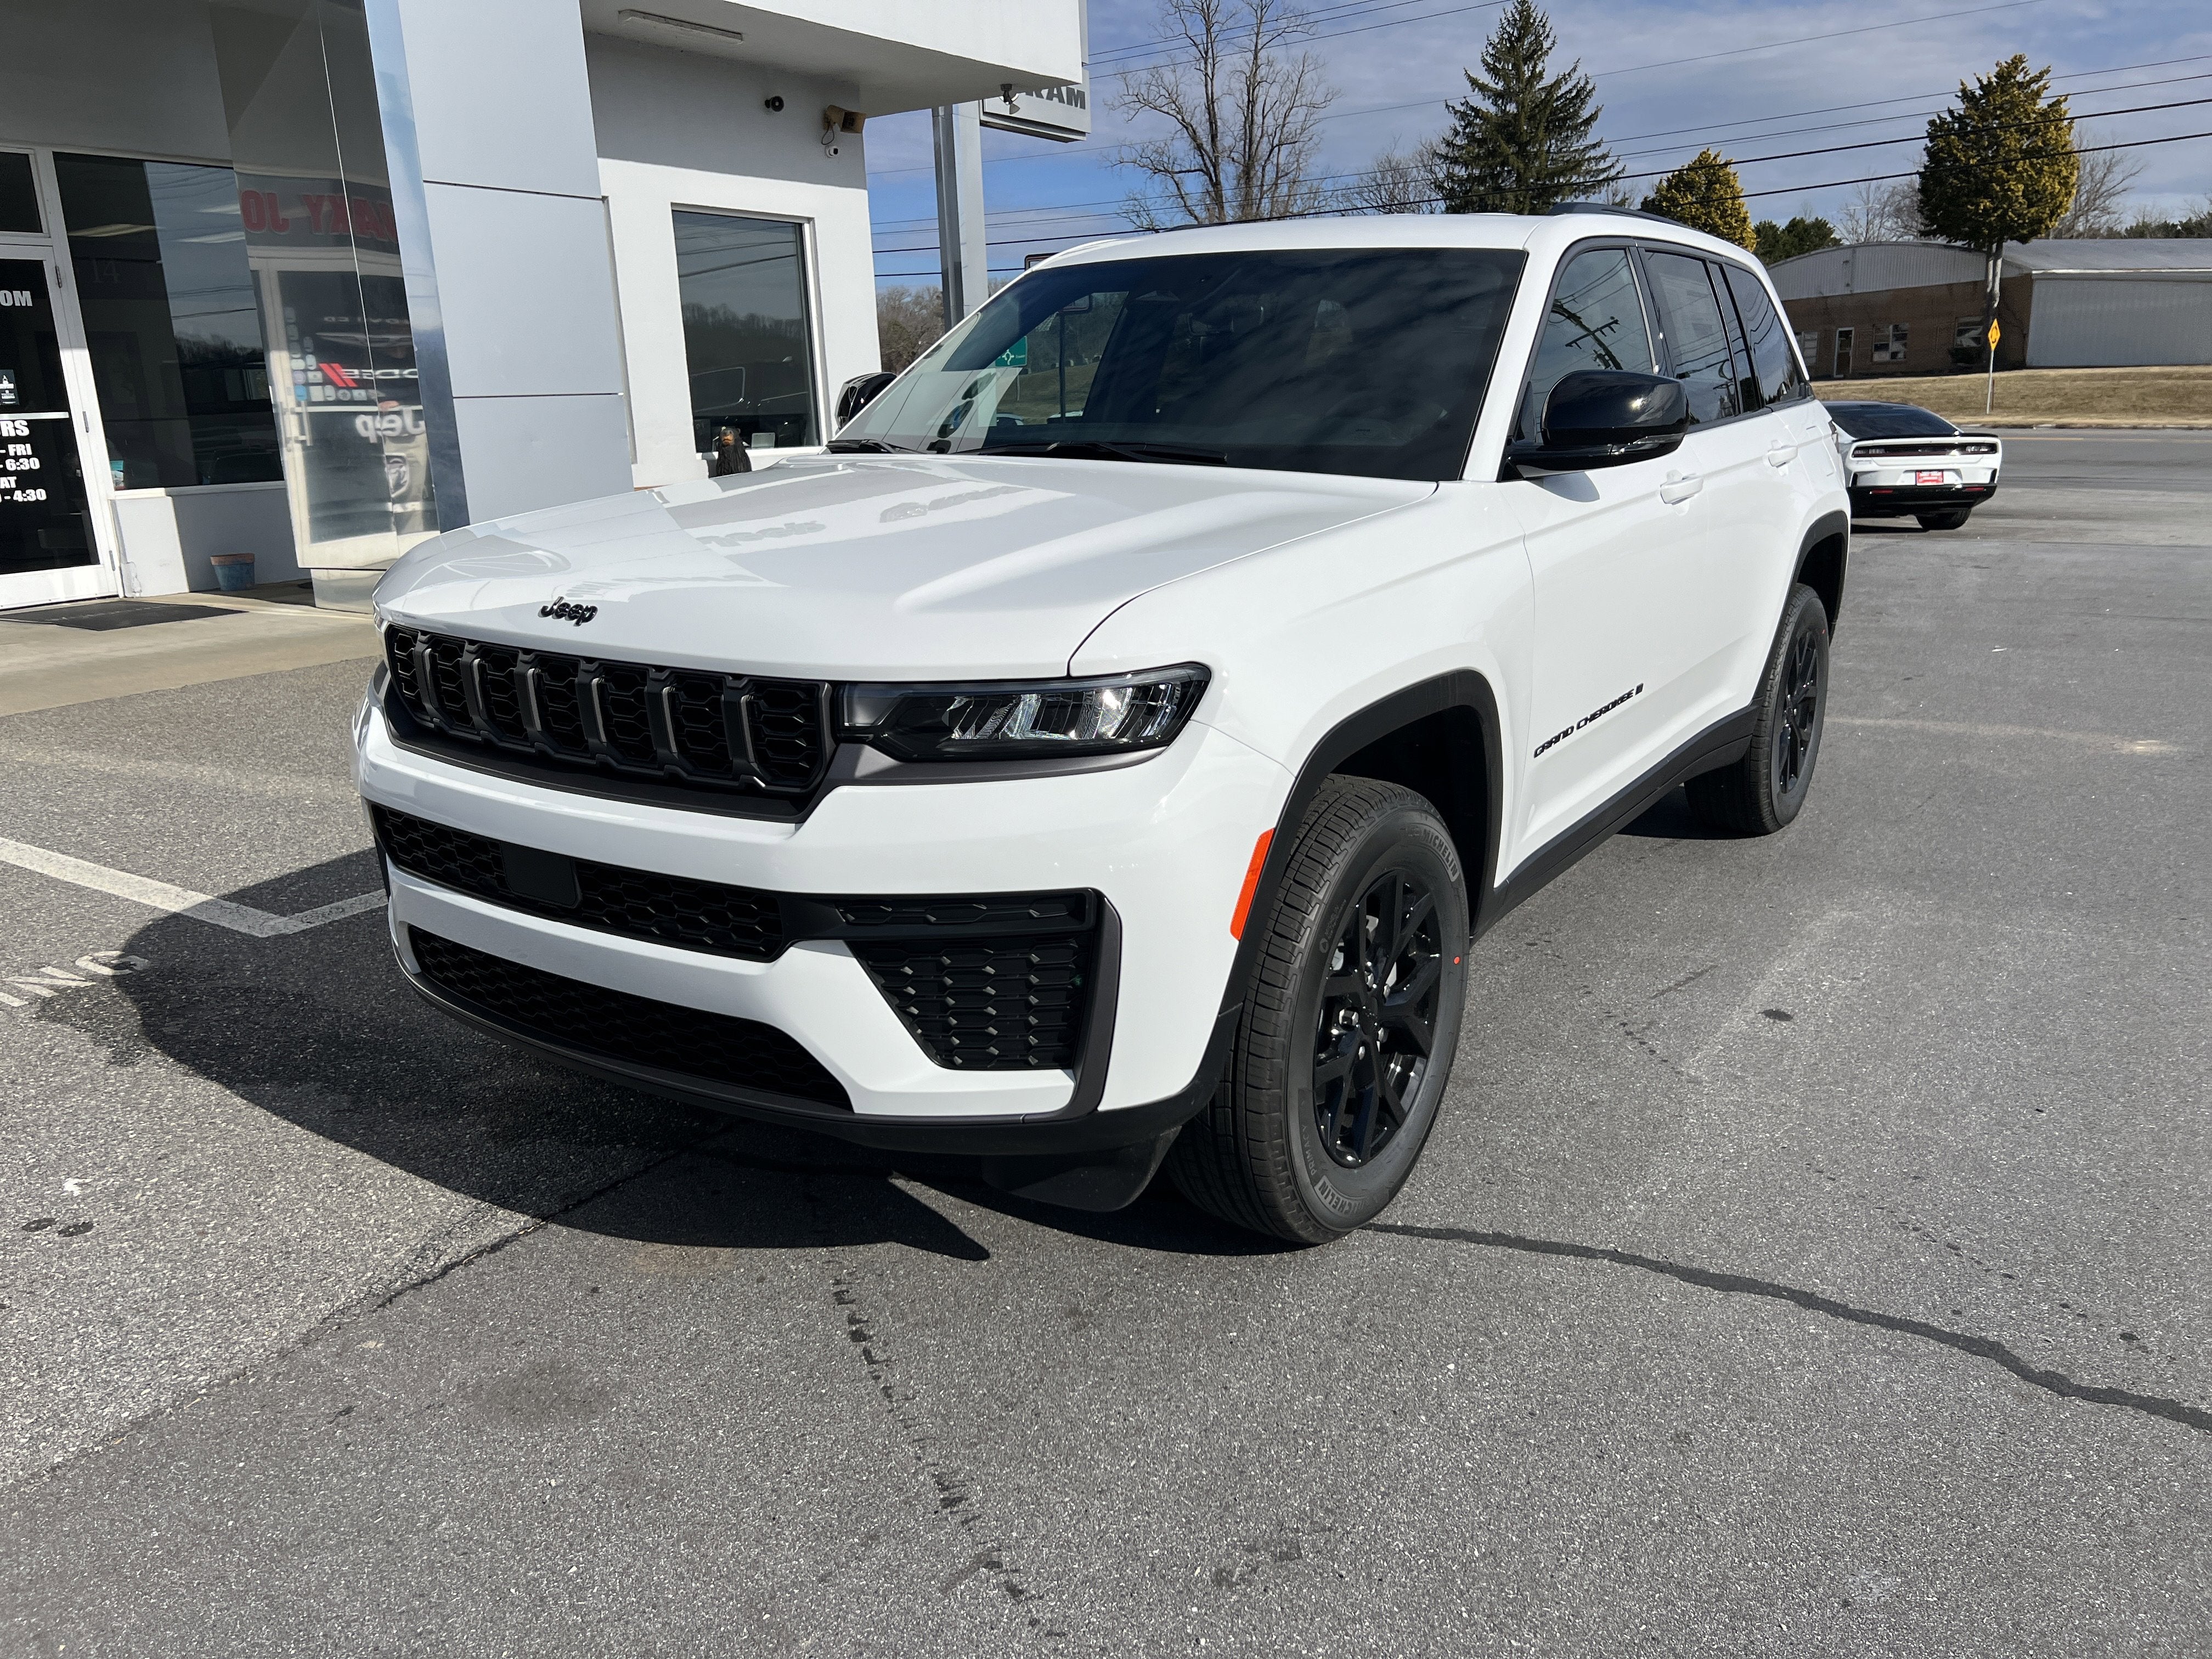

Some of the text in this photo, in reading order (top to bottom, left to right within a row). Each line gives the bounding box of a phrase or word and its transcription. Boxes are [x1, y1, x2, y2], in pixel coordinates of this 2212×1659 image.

[0, 419, 30, 437] RS
[8, 443, 32, 456] FRI
[5, 457, 41, 471] 6:30
[13, 488, 47, 502] 4:30
[538, 596, 598, 627] Jeep
[1533, 688, 1635, 759] GRAND CHEROKEE
[1422, 828, 1458, 877] MICHELIN
[1301, 1125, 1317, 1176] PRIMACY
